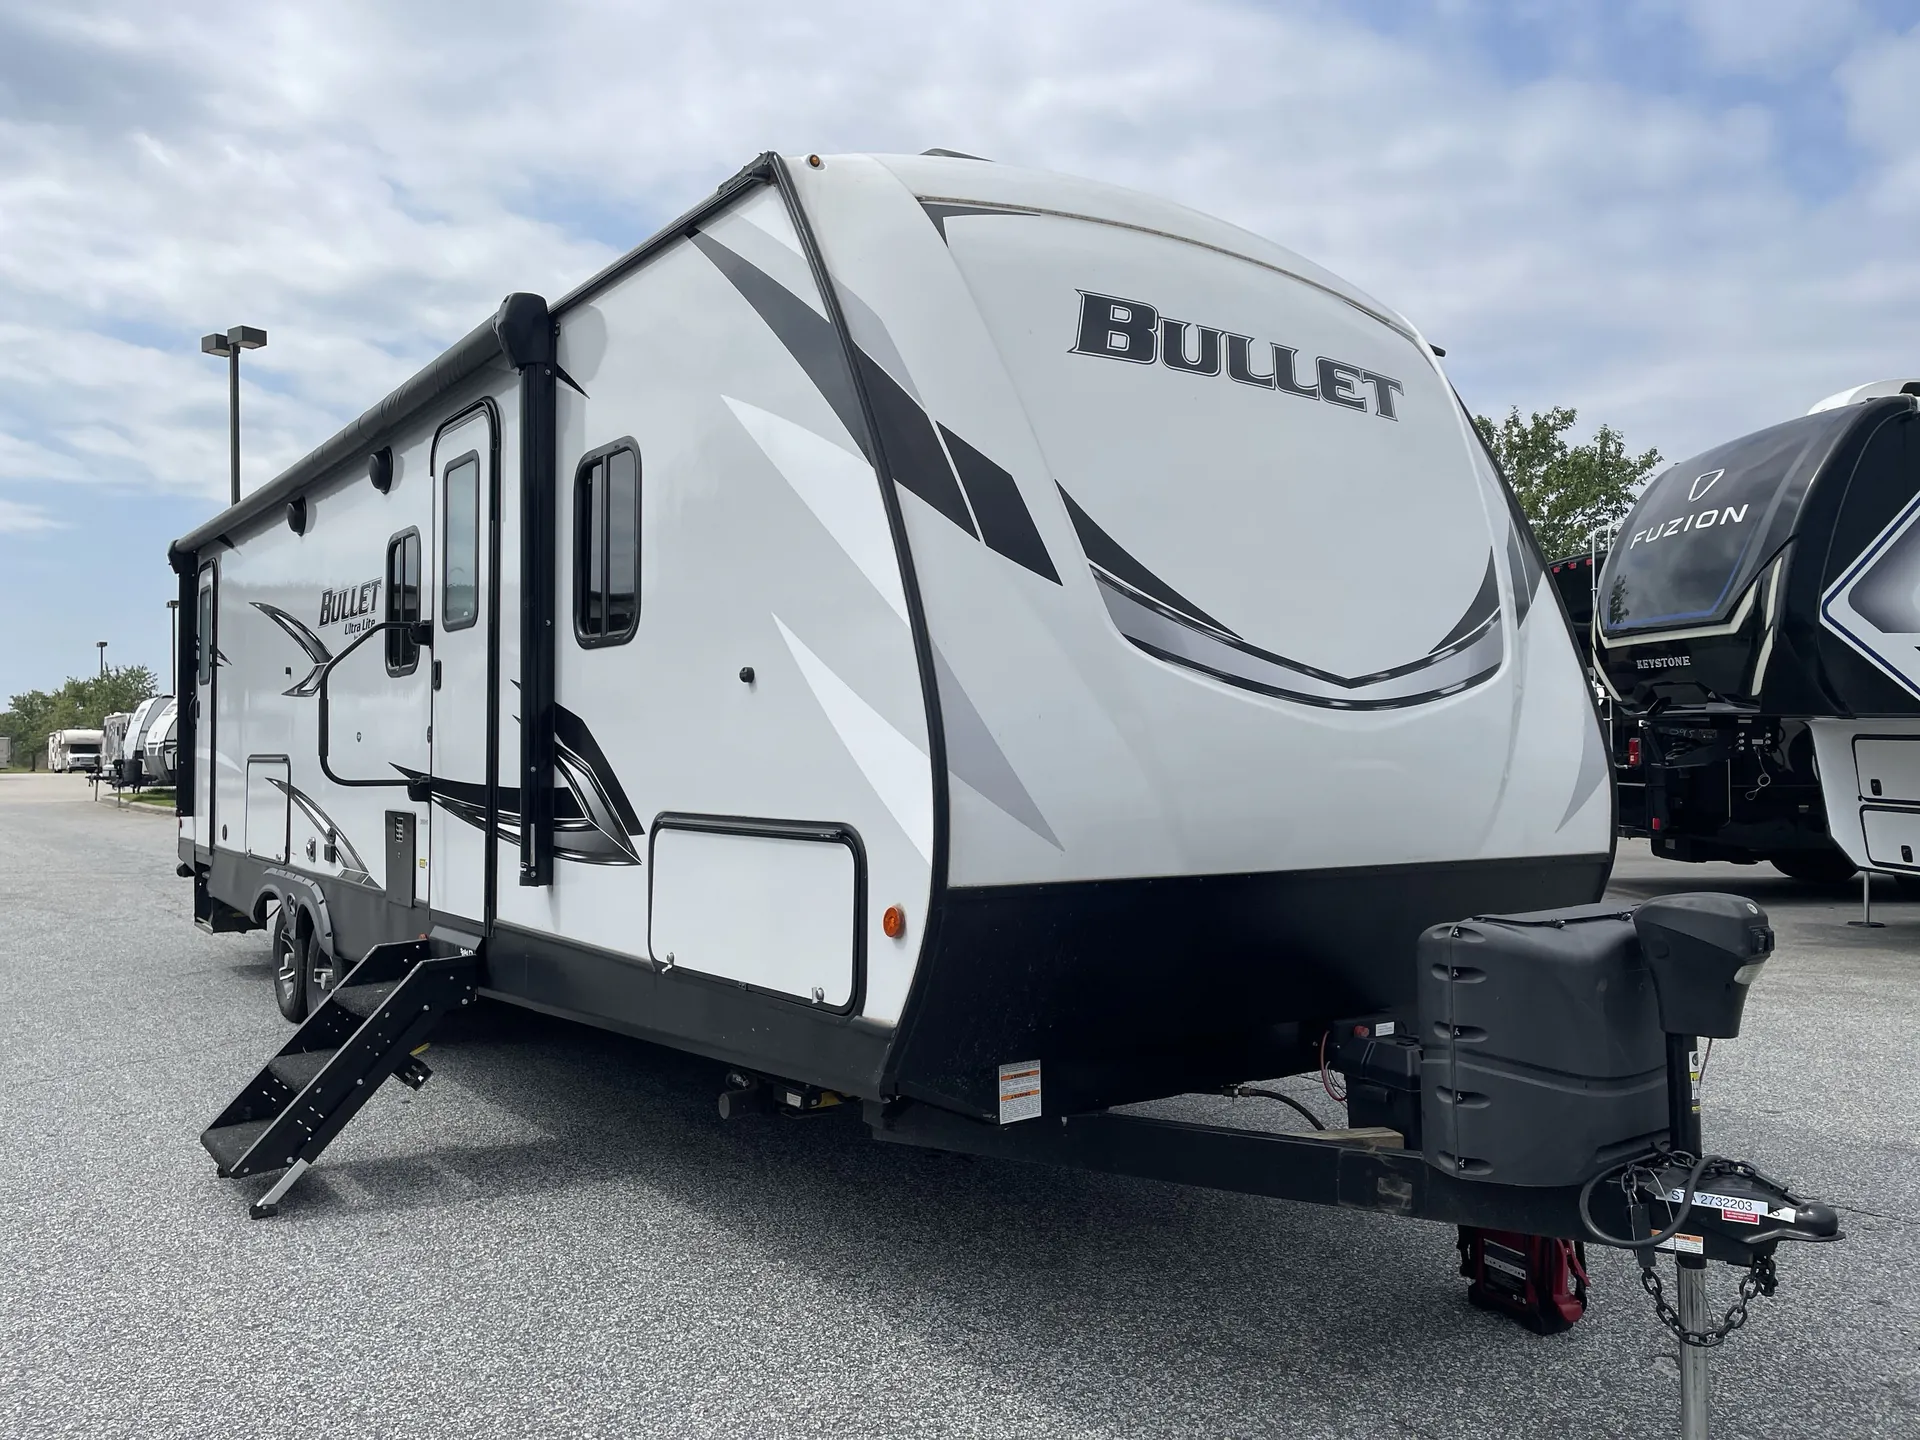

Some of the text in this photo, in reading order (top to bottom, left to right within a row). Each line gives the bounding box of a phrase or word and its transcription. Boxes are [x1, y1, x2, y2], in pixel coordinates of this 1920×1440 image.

[1066, 288, 1405, 422] BULLET
[1629, 503, 1750, 550] FUZION
[317, 576, 383, 629] BULLET
[344, 618, 376, 635] Ultra Lite
[1636, 655, 1691, 670] KEYSTONE
[1700, 1194, 1753, 1212] 2732203
